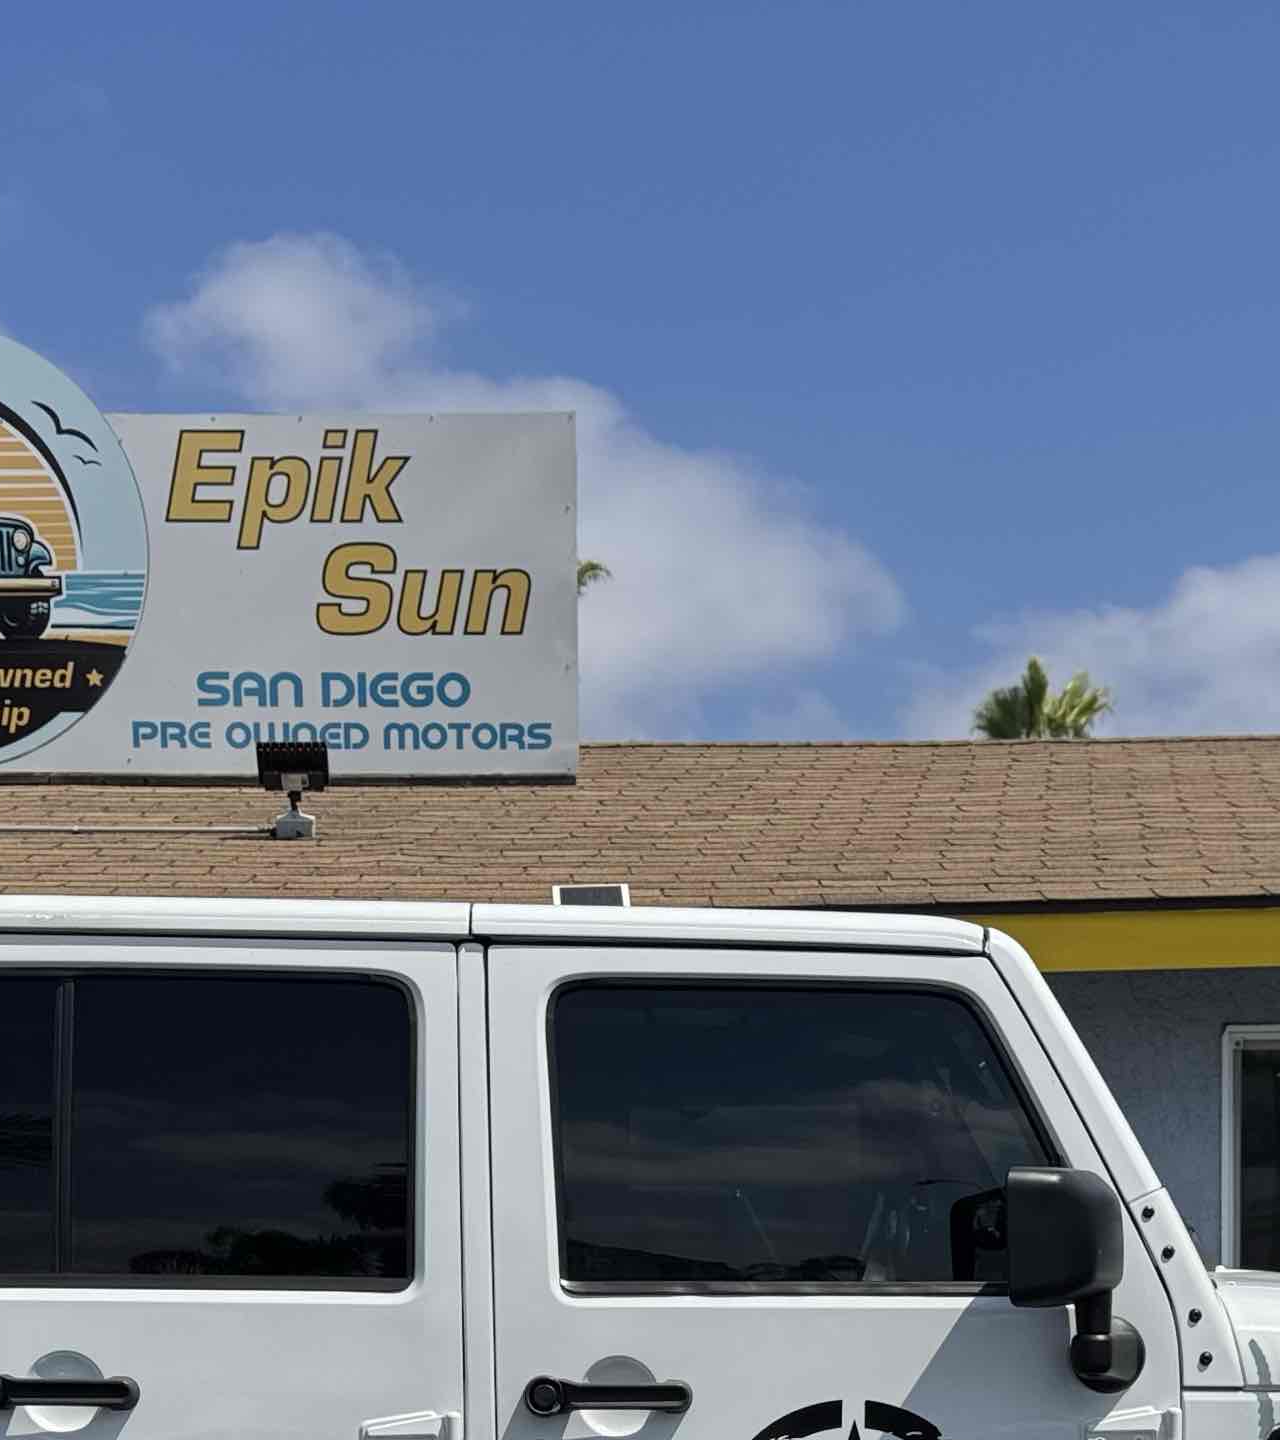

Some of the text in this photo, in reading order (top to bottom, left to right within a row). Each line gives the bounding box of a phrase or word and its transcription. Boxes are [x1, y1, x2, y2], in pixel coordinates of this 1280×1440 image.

[165, 429, 411, 549] Epik
[316, 541, 531, 635] Sun
[196, 671, 472, 708] SAN DIEGO
[132, 721, 553, 750] PRE OWNED MOTORS
